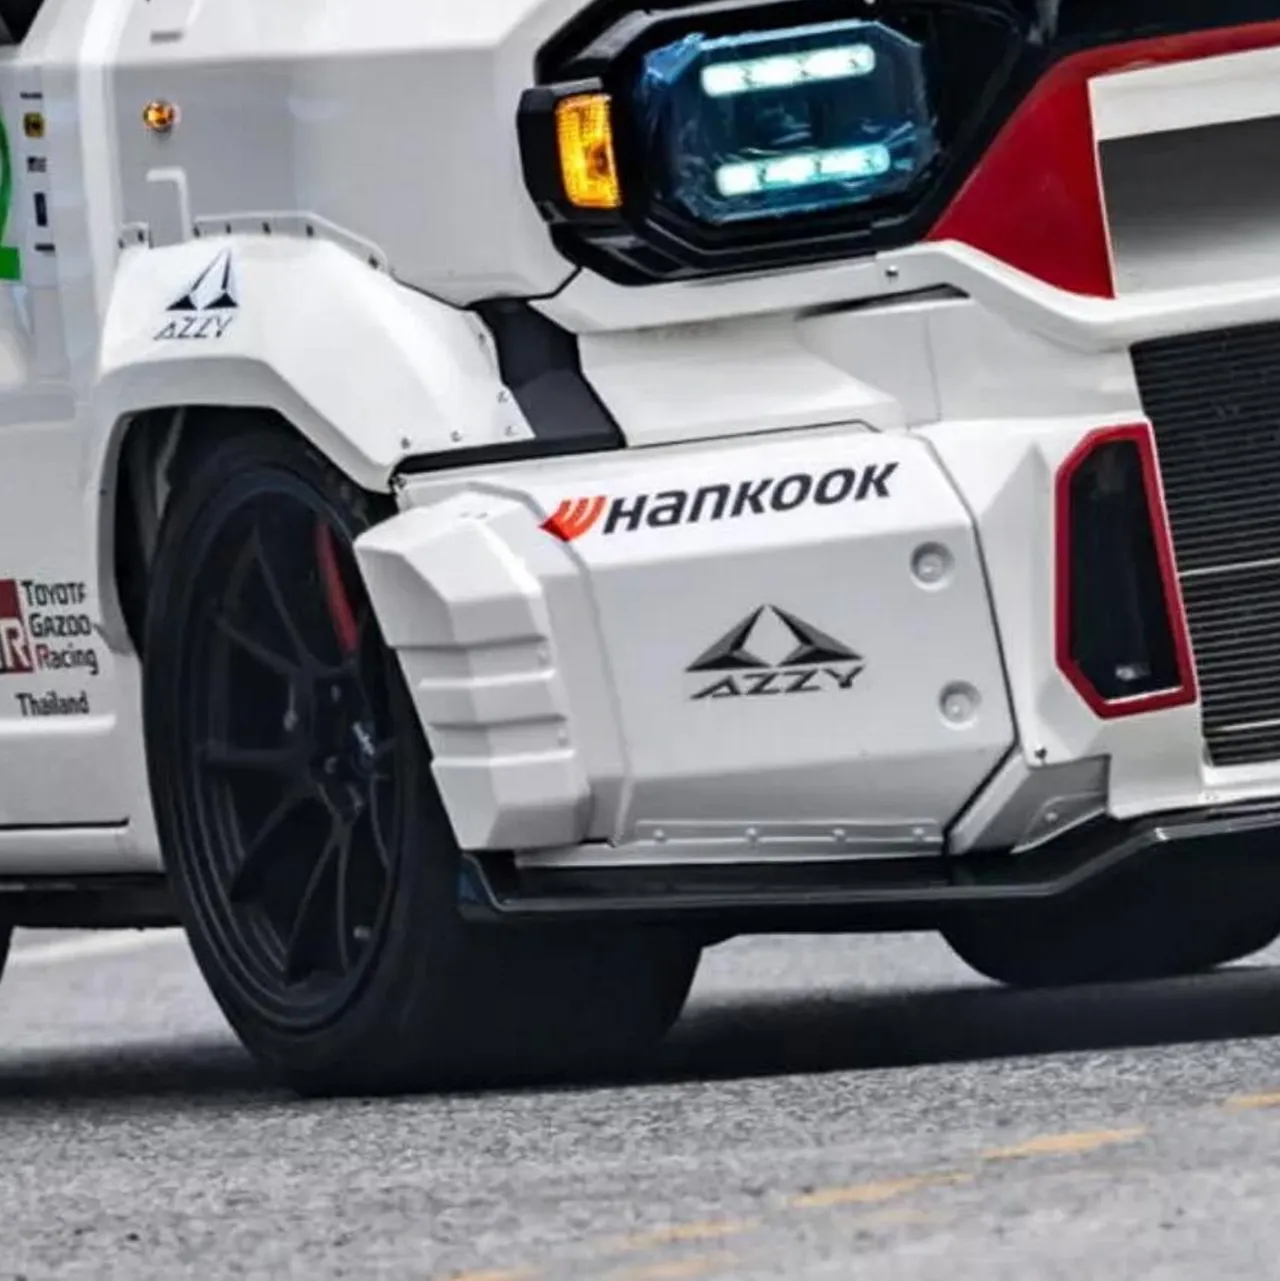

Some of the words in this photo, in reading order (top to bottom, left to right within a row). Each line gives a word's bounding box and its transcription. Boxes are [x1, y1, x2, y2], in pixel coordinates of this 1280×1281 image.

[152, 315, 233, 341] AZZY
[29, 612, 92, 638] GAZOO
[35, 641, 100, 677] Racing
[690, 664, 867, 702] AZZY
[14, 690, 91, 717] Thailand
